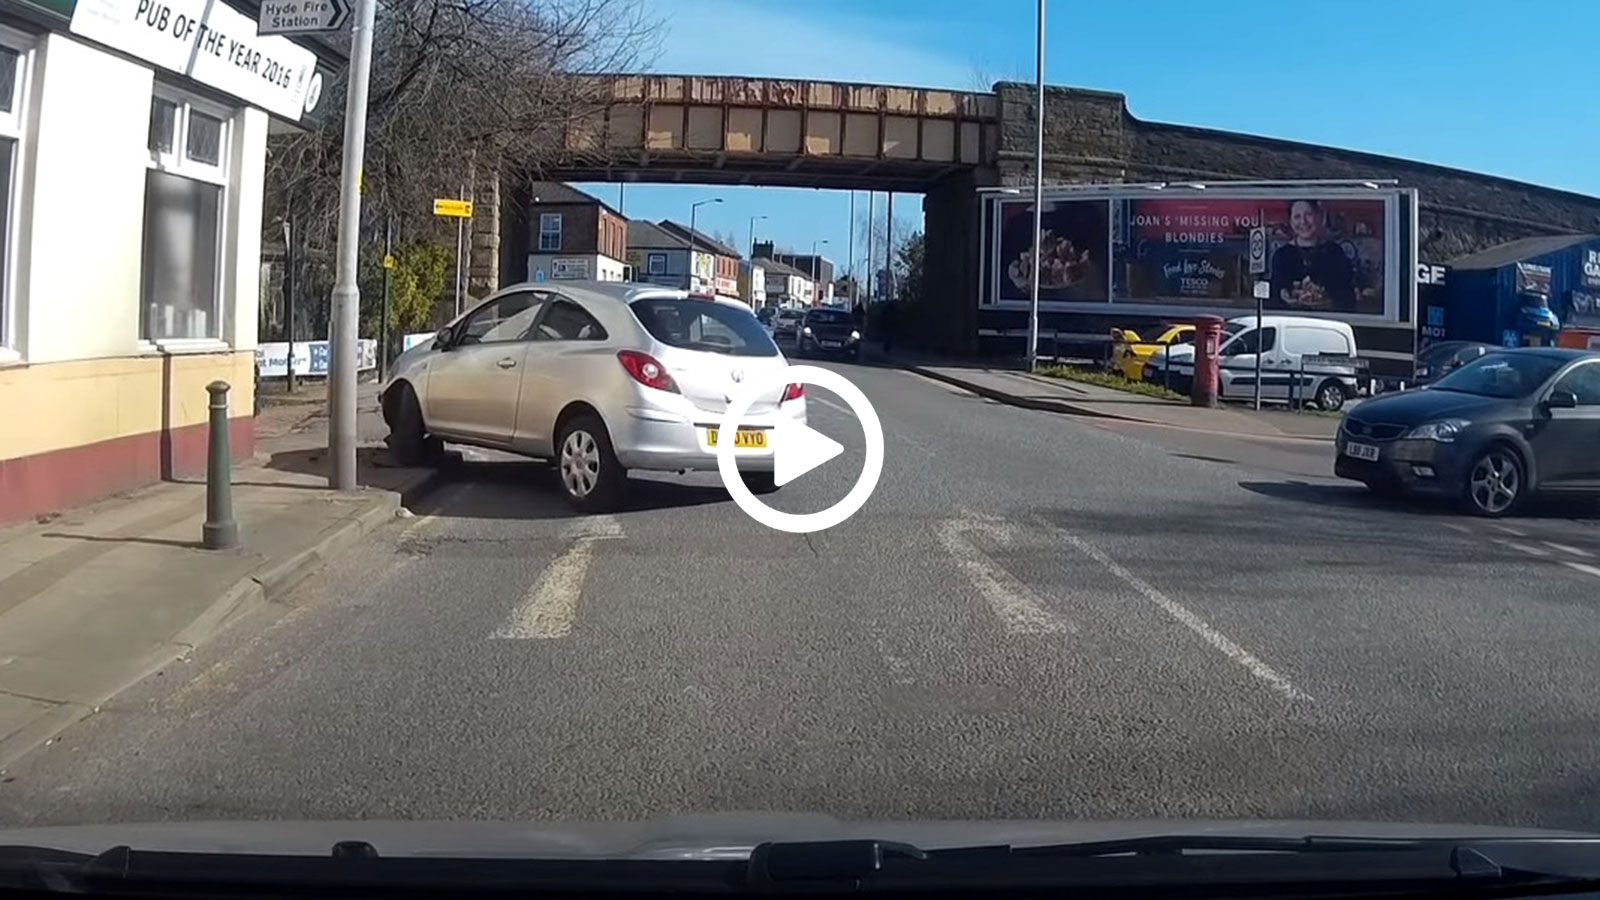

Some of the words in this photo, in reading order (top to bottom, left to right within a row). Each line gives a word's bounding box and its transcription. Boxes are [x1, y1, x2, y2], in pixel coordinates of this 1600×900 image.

[265, 3, 297, 15] Hyde
[304, 1, 328, 12] Fire
[272, 16, 318, 28] Station
[135, 0, 171, 32] PUB
[173, 14, 196, 41] OF
[198, 24, 226, 57] THE
[228, 39, 261, 74] YEAR
[262, 57, 291, 89] 2016
[1130, 215, 1171, 226] JOAN'S
[1165, 232, 1224, 243] BLONDIES
[1422, 326, 1445, 337] MOT
